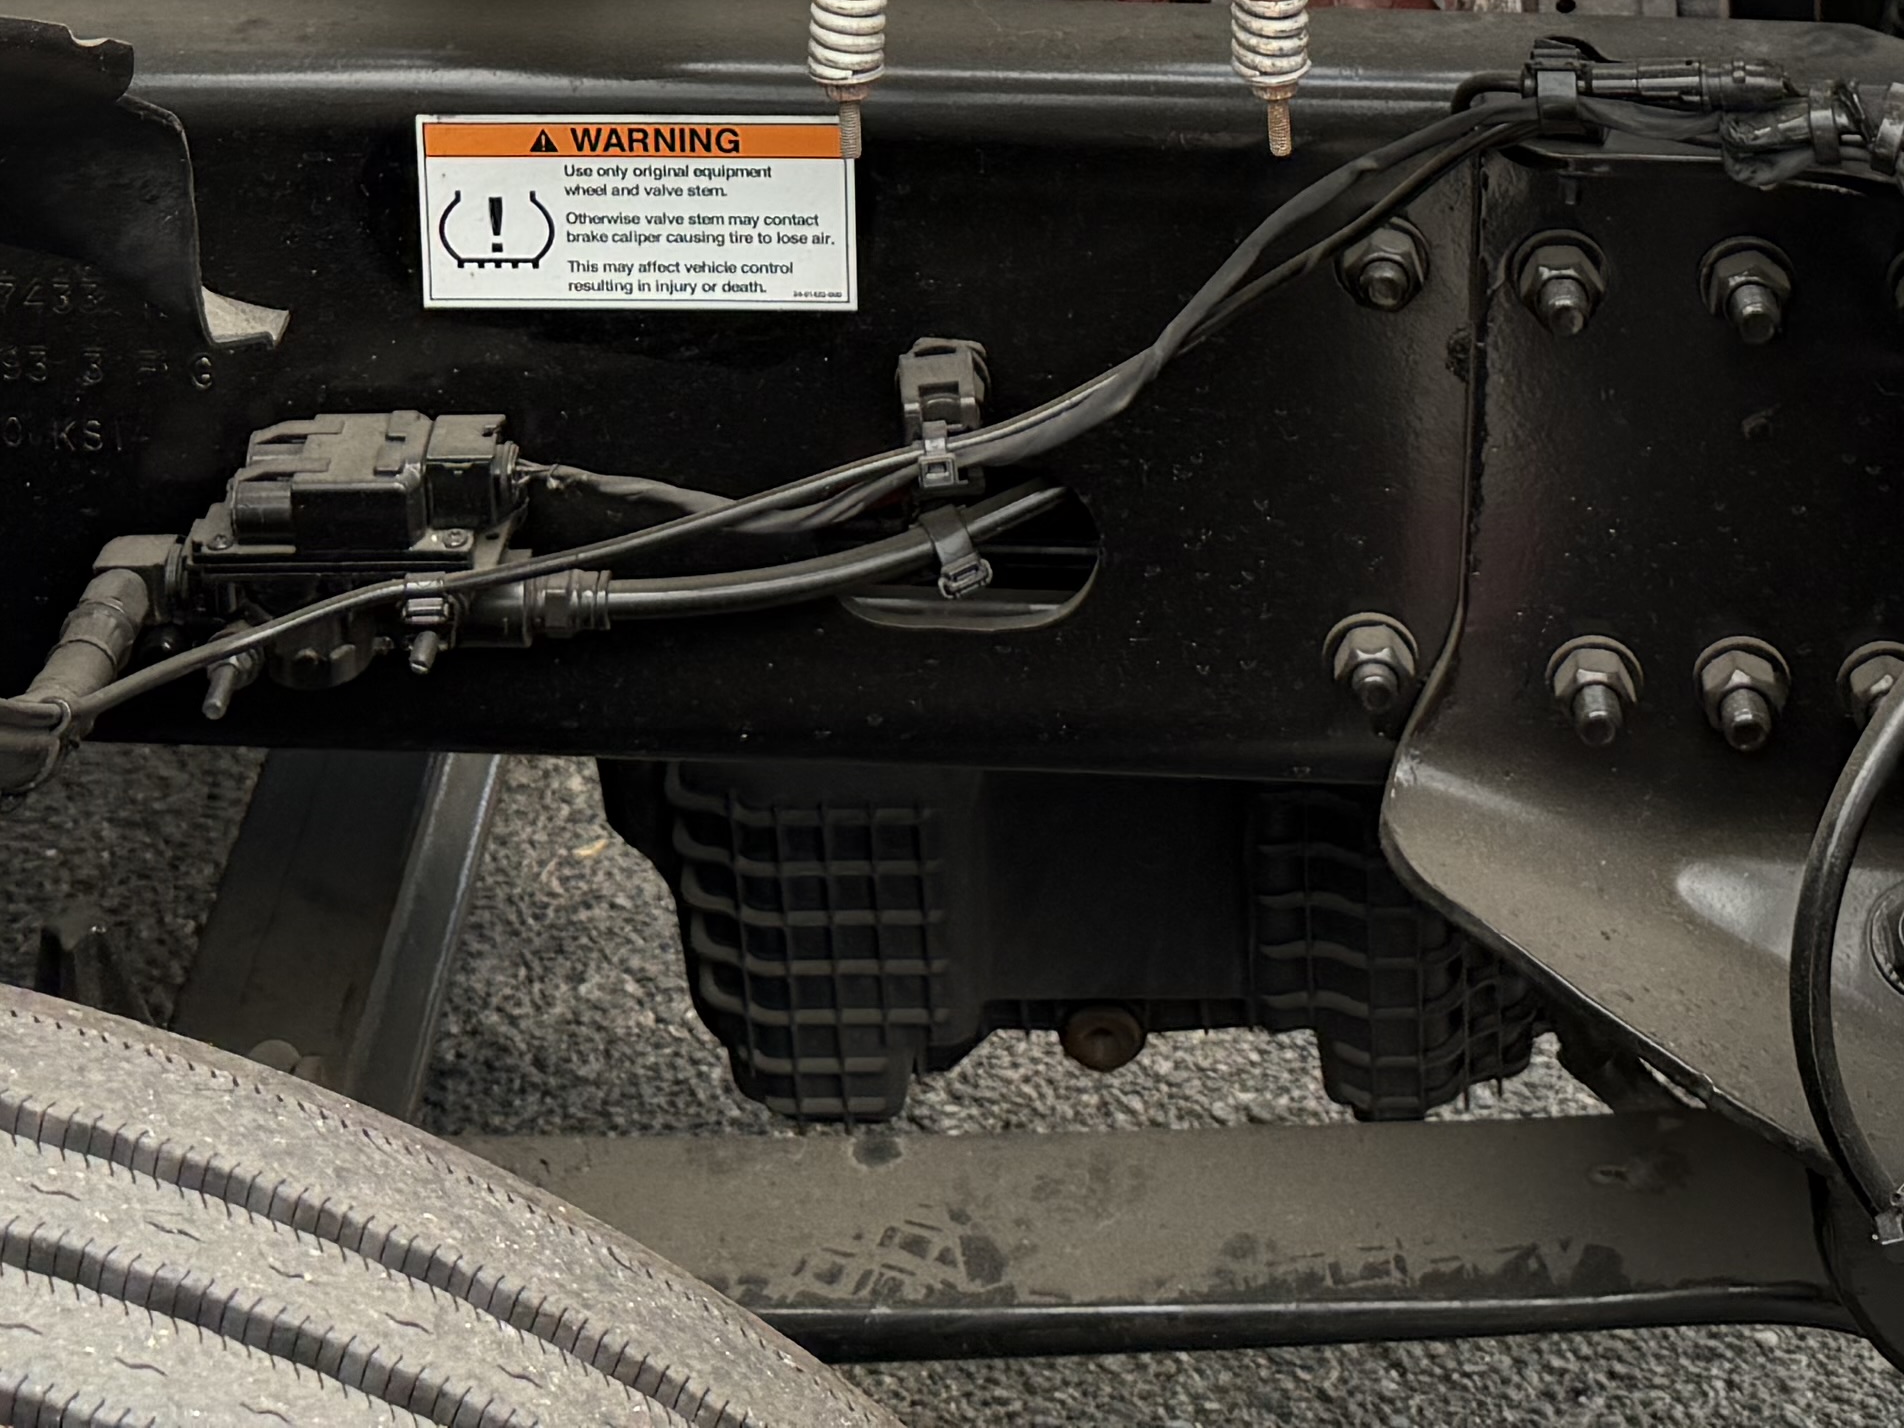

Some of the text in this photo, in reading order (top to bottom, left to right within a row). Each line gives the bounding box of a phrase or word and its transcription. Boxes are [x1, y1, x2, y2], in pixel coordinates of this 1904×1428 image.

[570, 127, 741, 154] WARNING
[564, 164, 772, 180] Use only original equipment
[564, 183, 728, 197] wheel and valve stem.
[566, 211, 820, 229] Otherwise valve stem may contact
[567, 230, 836, 247] brake caliper causing tire to lose air.
[568, 259, 794, 276] This may affect vehicle control
[568, 279, 767, 296] resulting in injury or death.
